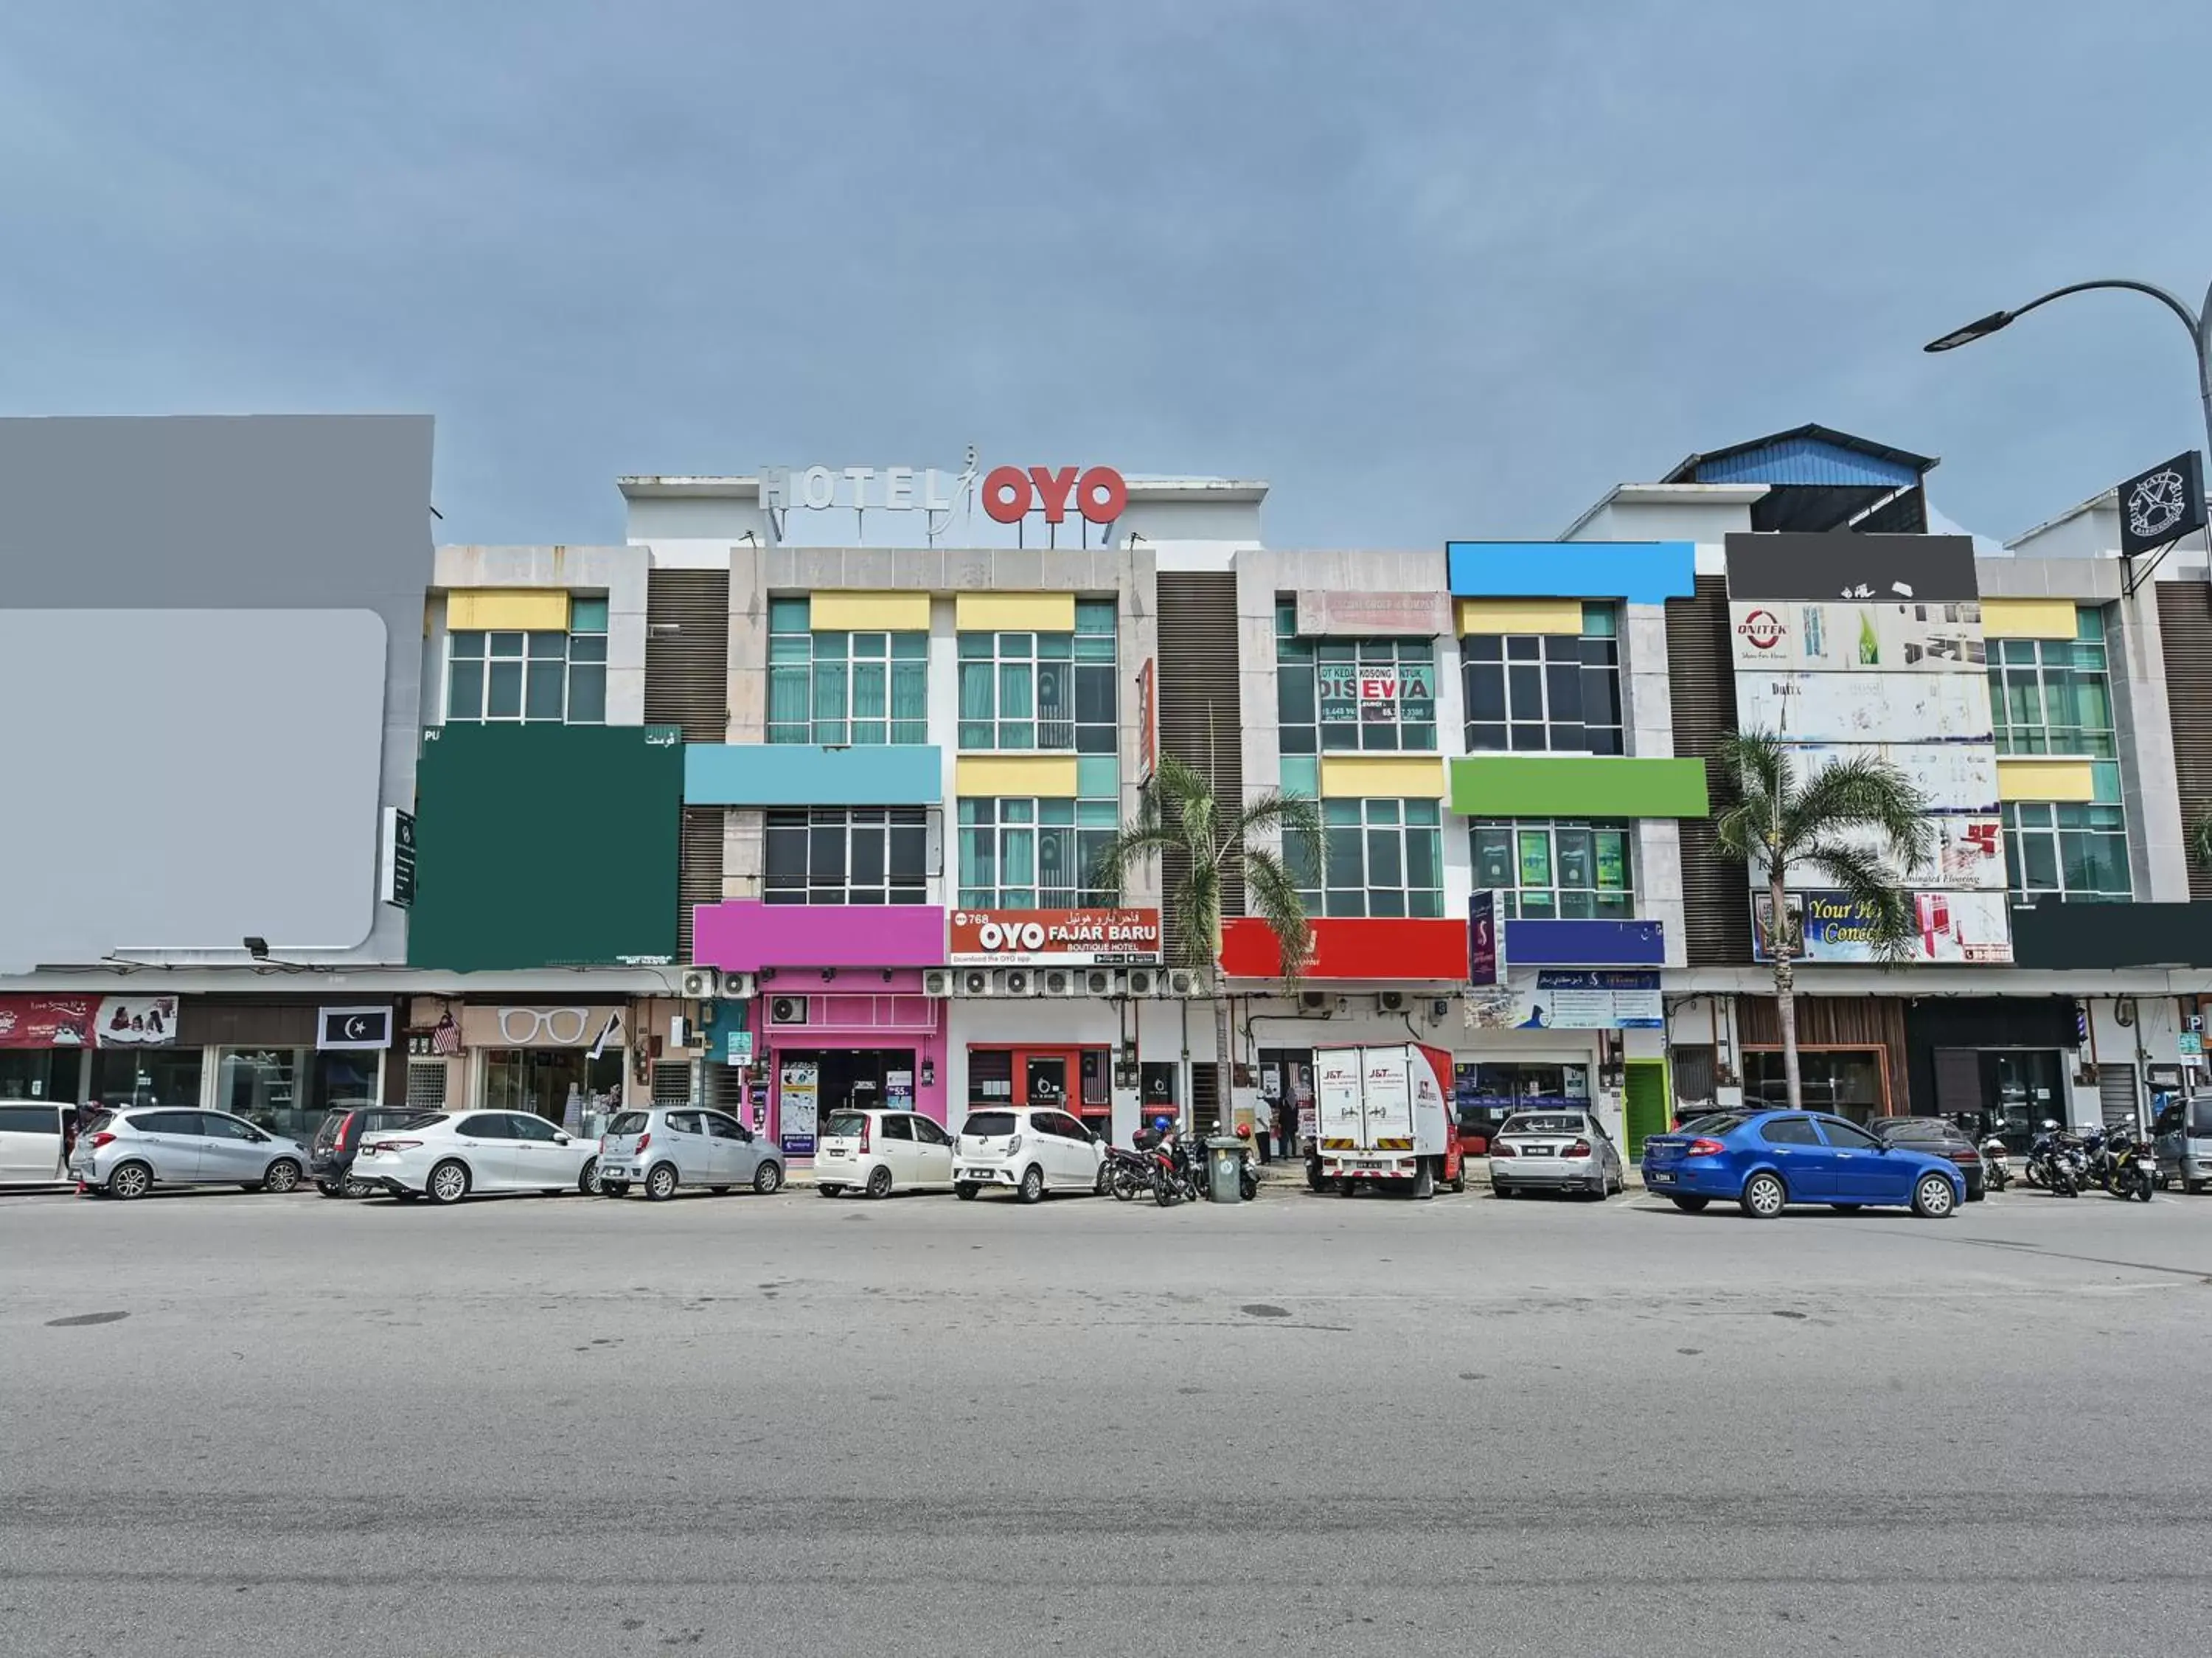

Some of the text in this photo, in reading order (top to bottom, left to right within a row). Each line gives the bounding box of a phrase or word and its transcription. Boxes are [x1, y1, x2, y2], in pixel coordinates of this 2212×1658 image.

[759, 465, 950, 510] HOTEL
[981, 465, 1127, 524] OYO
[1321, 679, 1428, 698] DISEWA
[1810, 898, 1852, 919] Your
[968, 915, 989, 924] 768
[979, 923, 1045, 949] OYO
[1048, 926, 1157, 940] FAJAR BARU
[1067, 943, 1109, 951] BOUTIQUE
[2191, 1017, 2201, 1030] P
[1324, 1070, 1343, 1080] J&T
[1368, 1069, 1389, 1078] J&T
